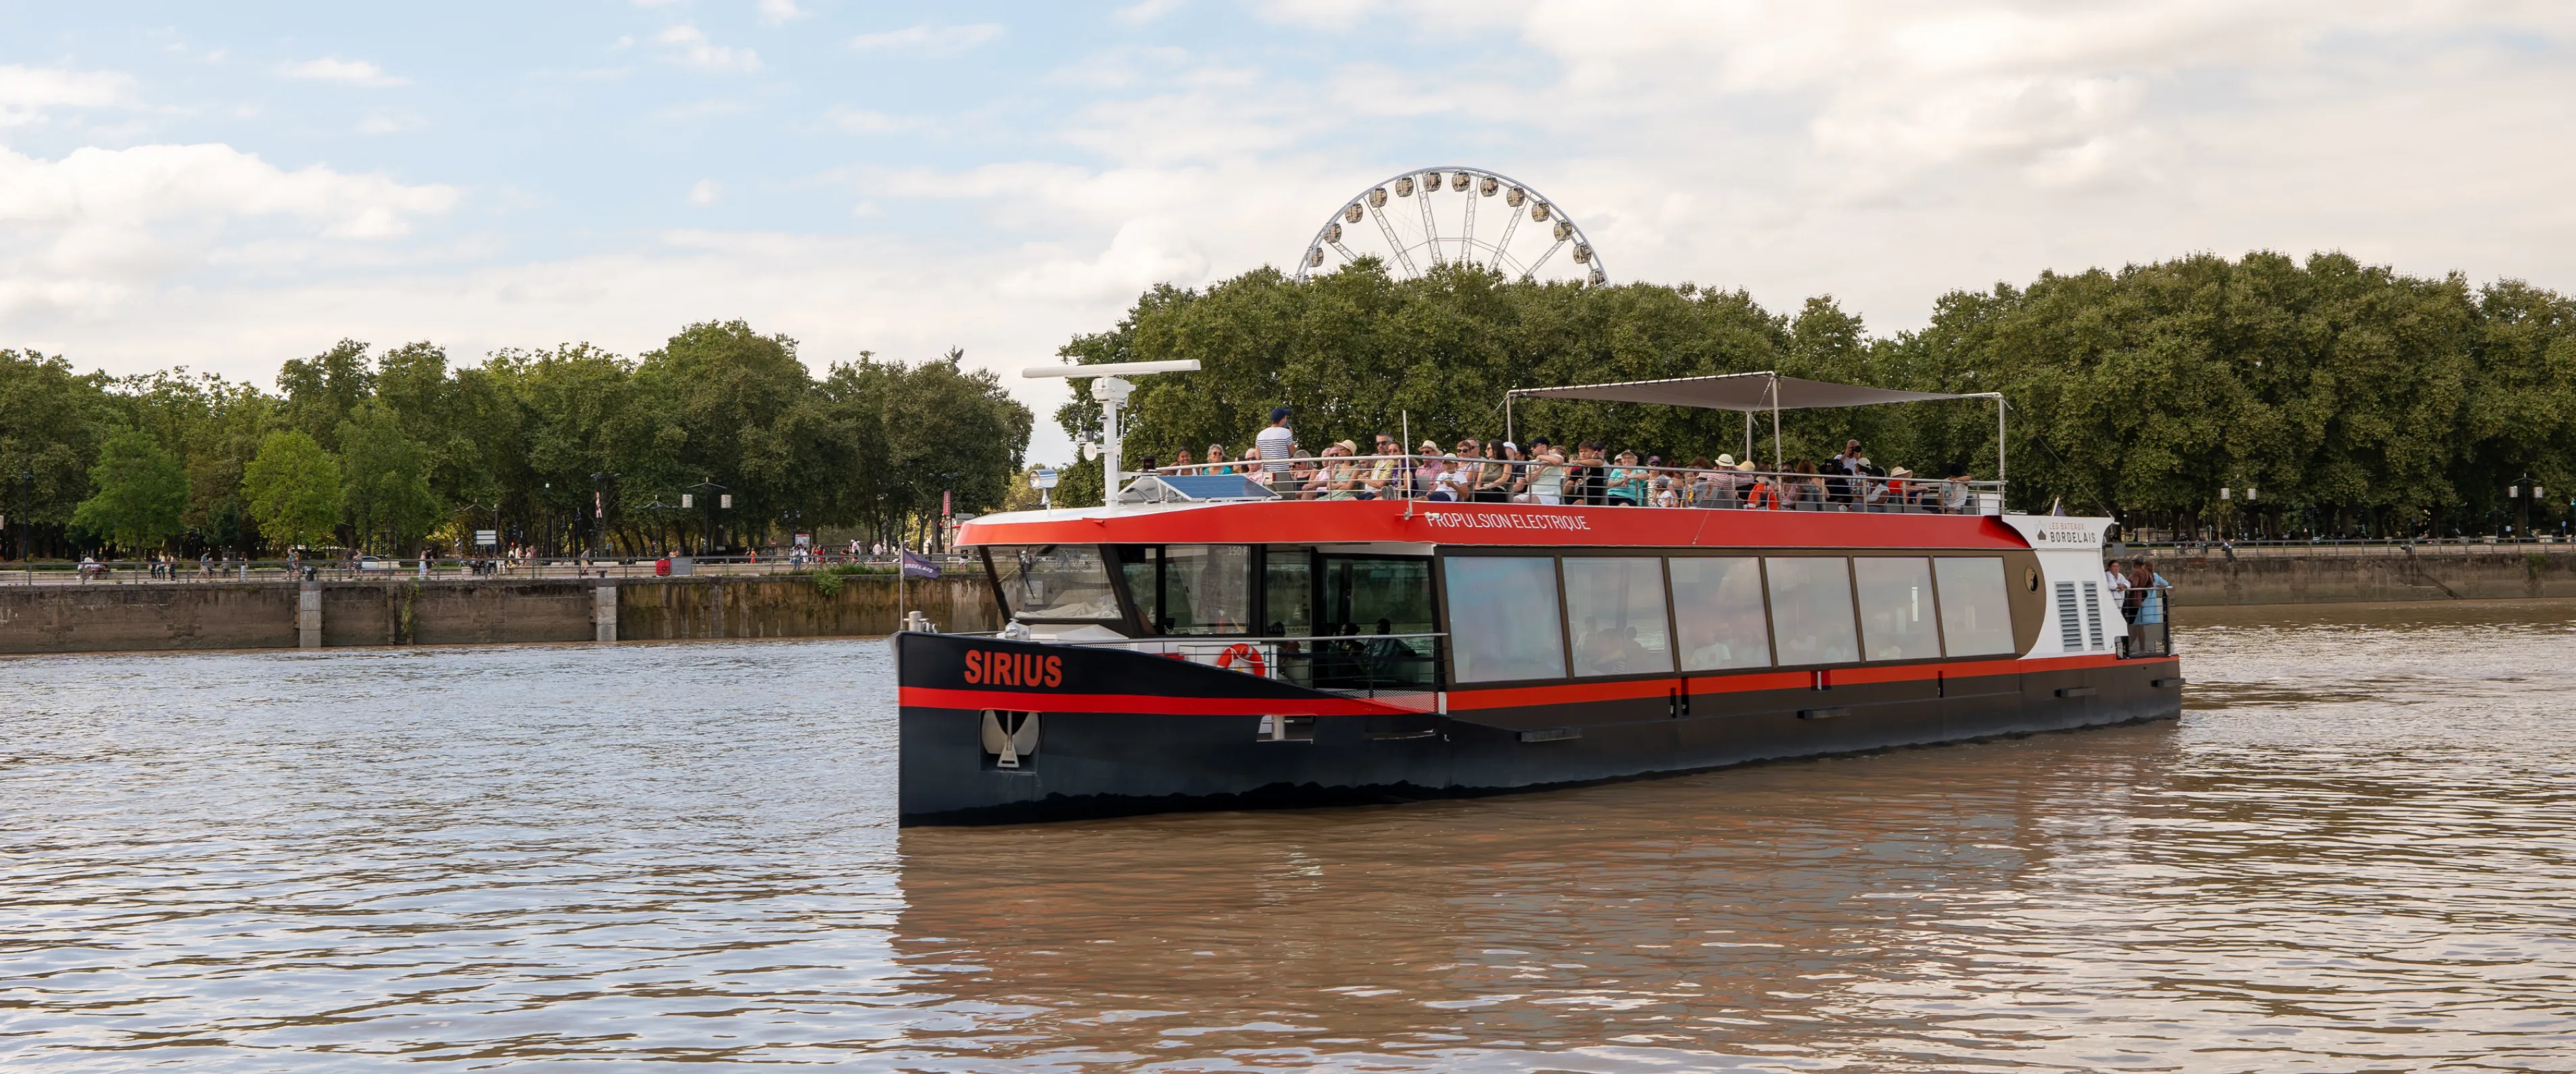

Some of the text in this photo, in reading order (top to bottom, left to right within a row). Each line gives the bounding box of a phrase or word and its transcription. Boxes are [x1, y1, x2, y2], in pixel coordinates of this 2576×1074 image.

[1425, 513, 1590, 530] PROPULSION ELECTRIQUE
[2050, 532, 2096, 542] BORDELAIS
[964, 649, 1062, 687] SIRIUS
